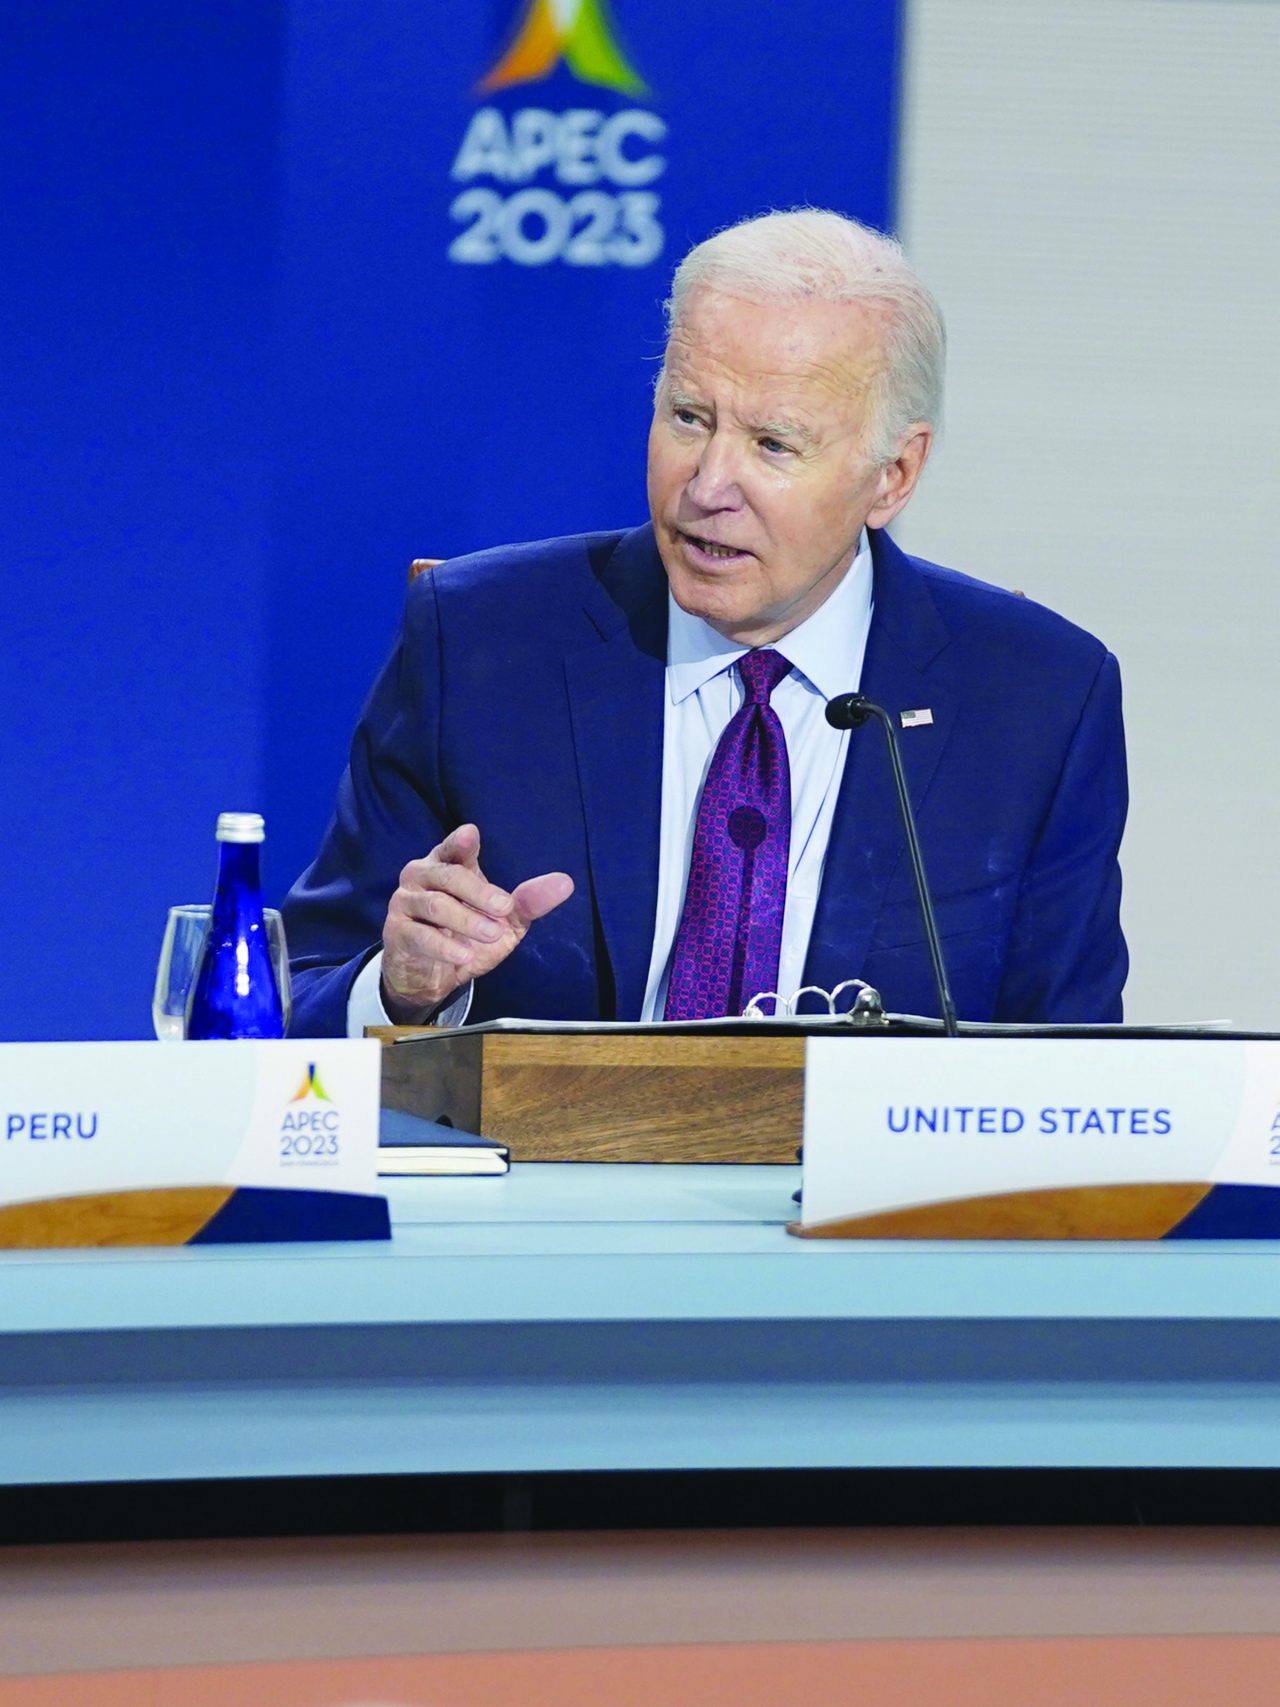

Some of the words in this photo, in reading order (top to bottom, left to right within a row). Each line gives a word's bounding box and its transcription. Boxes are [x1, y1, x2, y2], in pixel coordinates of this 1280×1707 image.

[450, 107, 667, 186] APEC
[448, 187, 664, 268] 2023
[6, 1112, 98, 1140] PERU
[281, 1110, 339, 1131] APEC
[887, 1106, 1024, 1134] UNITED
[1039, 1107, 1172, 1135] STATES
[280, 1134, 338, 1155] 2023
